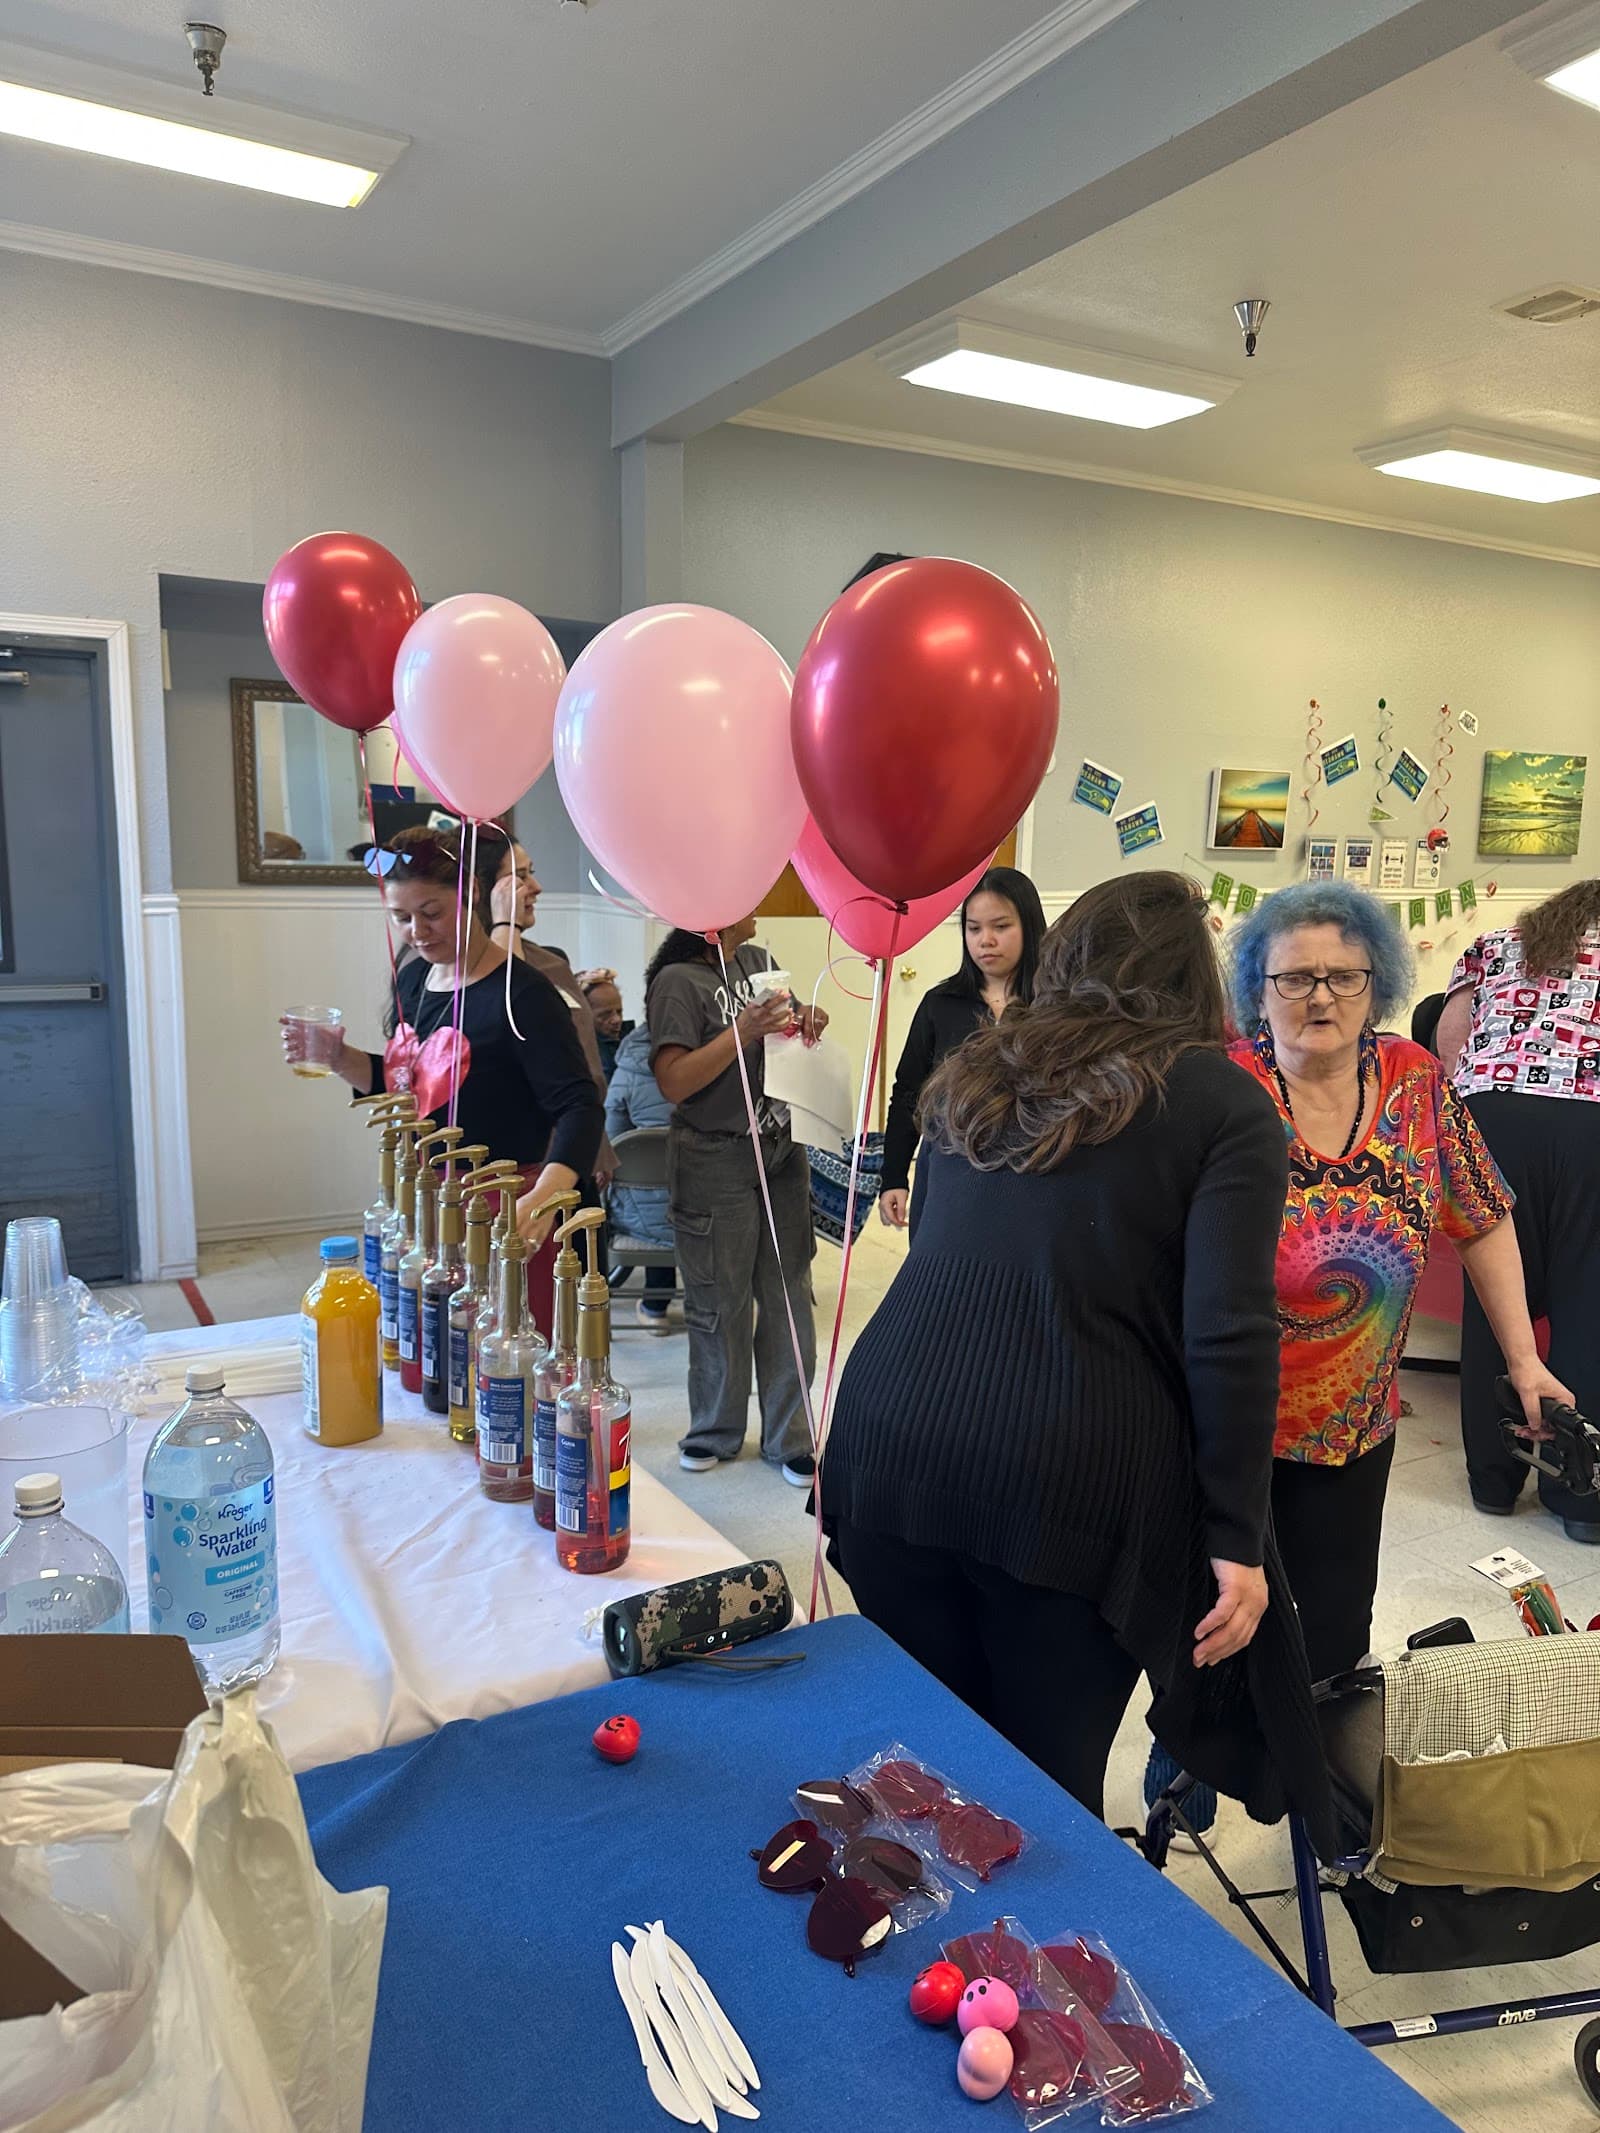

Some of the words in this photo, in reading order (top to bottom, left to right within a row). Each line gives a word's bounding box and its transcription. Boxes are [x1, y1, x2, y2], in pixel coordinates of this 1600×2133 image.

[218, 1504, 253, 1521] Kroger
[199, 1518, 267, 1550] Sparkling
[215, 1536, 258, 1558] Water
[217, 1560, 258, 1578] ORIGINAL
[1498, 2009, 1536, 2025] drive
